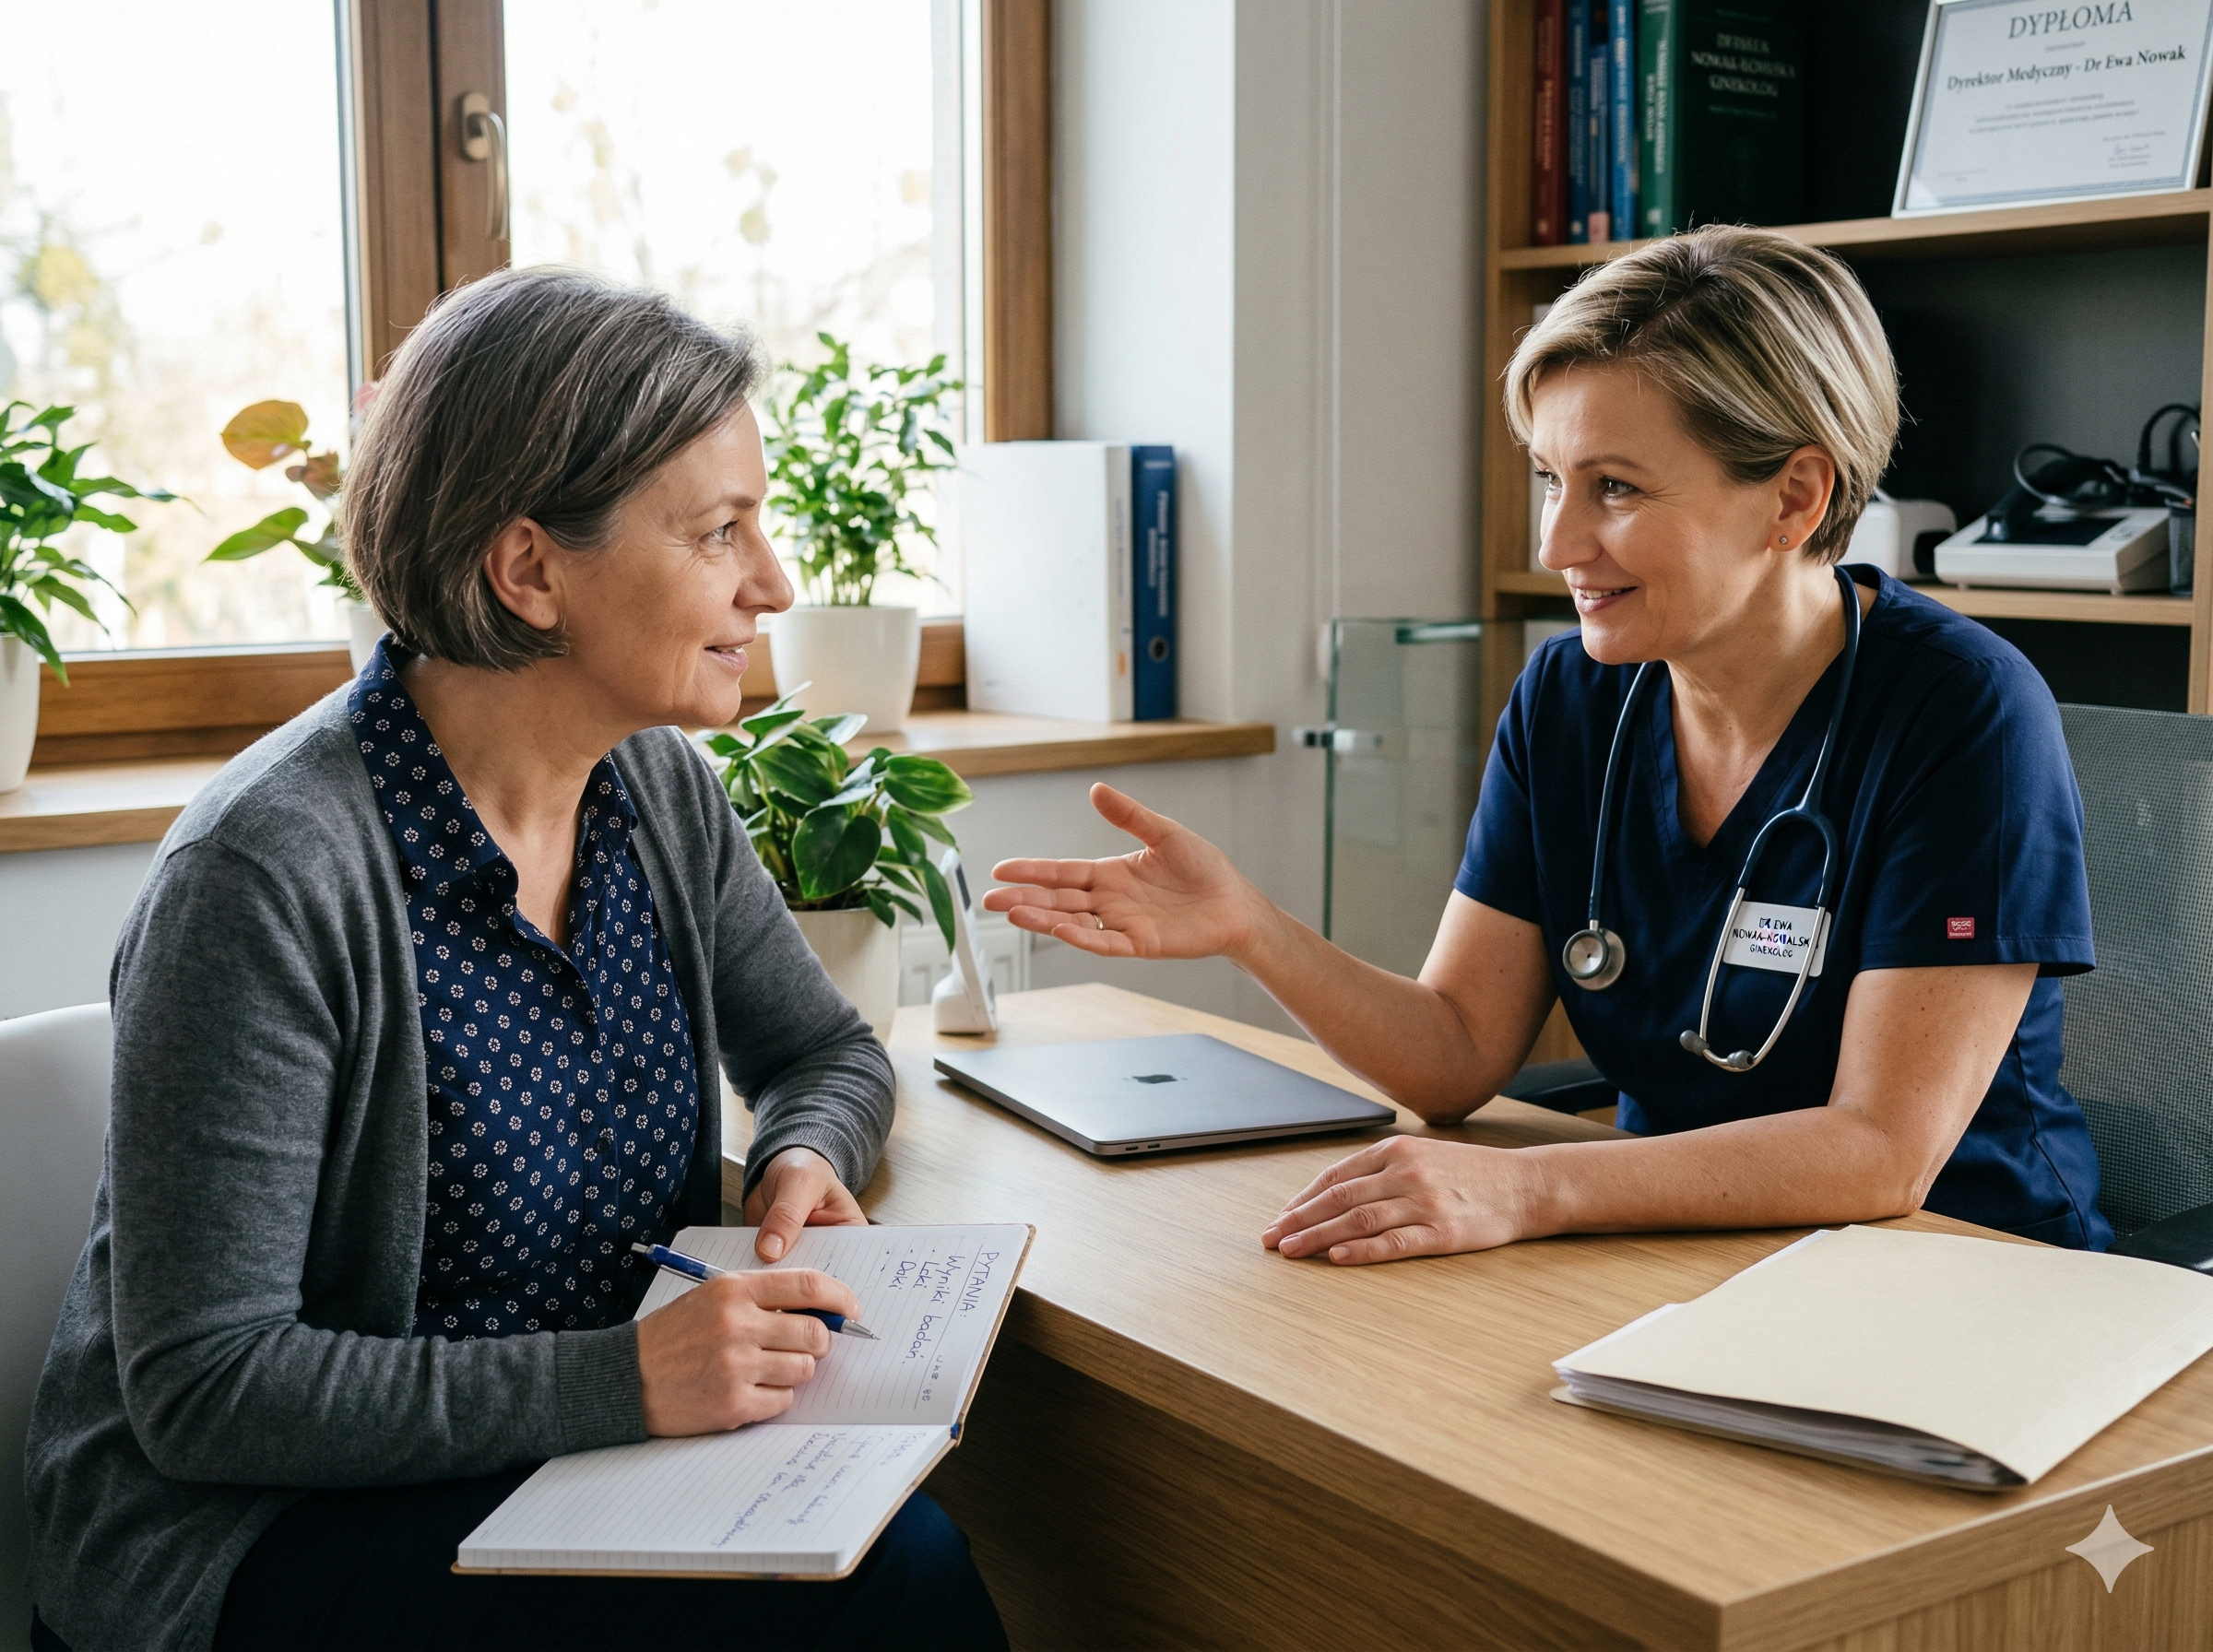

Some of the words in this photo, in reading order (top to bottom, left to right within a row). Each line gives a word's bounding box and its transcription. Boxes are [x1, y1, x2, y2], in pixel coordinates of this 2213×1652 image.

[1947, 71, 2005, 91] Dyrektor
[2006, 63, 2073, 84] Medyczny
[2084, 58, 2102, 72] Dr
[2105, 54, 2133, 69] Ewa
[2136, 44, 2186, 65] Nowak
[1773, 919, 1793, 931] EWA
[930, 1256, 965, 1304] Wyniki
[959, 1252, 1000, 1317] PYTANIA:
